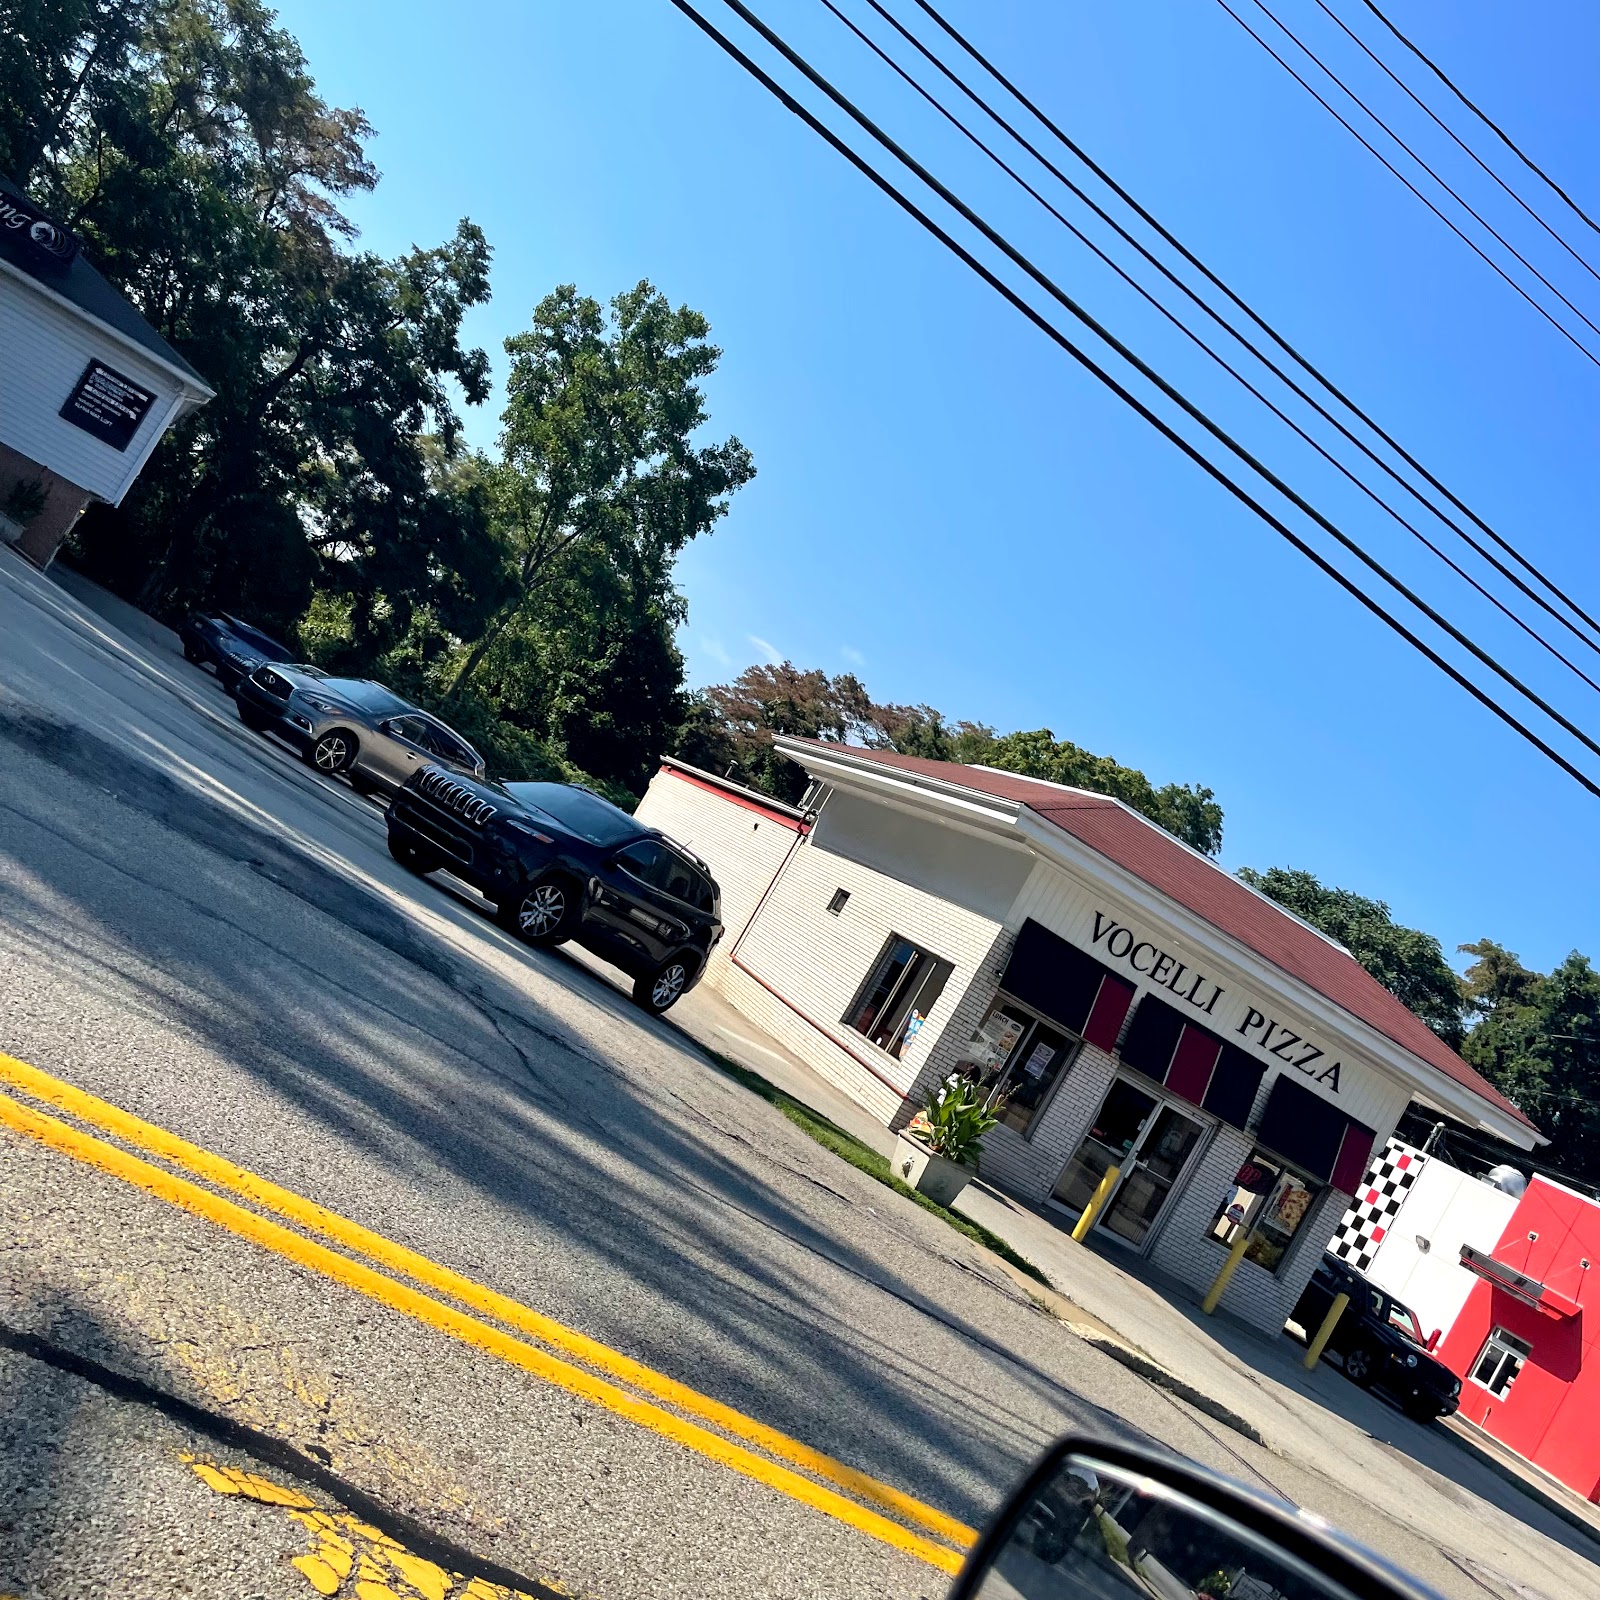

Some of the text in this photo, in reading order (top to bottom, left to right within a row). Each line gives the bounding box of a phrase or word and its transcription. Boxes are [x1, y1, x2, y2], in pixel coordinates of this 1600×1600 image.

[0, 192, 31, 228] ng
[1091, 910, 1342, 1094] VOCELLI PIZZA
